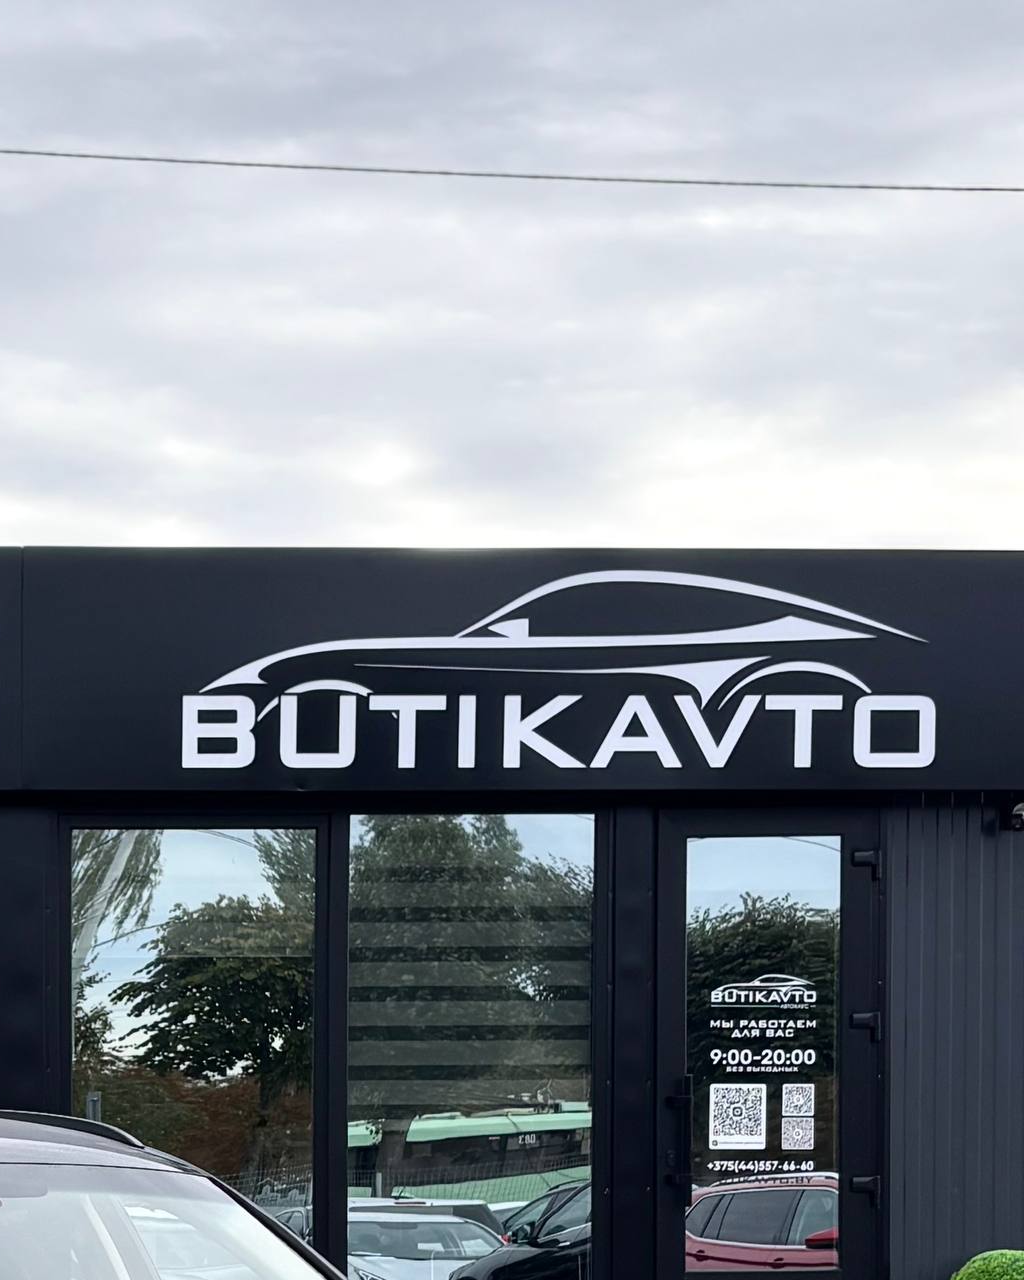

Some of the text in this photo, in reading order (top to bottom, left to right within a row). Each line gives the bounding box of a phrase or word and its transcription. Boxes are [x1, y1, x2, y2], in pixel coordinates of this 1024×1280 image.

[181, 694, 937, 770] BUTIKAVTO
[710, 989, 817, 1003] BUTIKAVTO
[709, 1019, 816, 1029] МЫ РАБОТАЕМ
[731, 1029, 795, 1038] ДЛЯ ВАС
[709, 1048, 817, 1066] 9:00-20:00
[707, 1160, 814, 1174] +375(44)557-66-60
